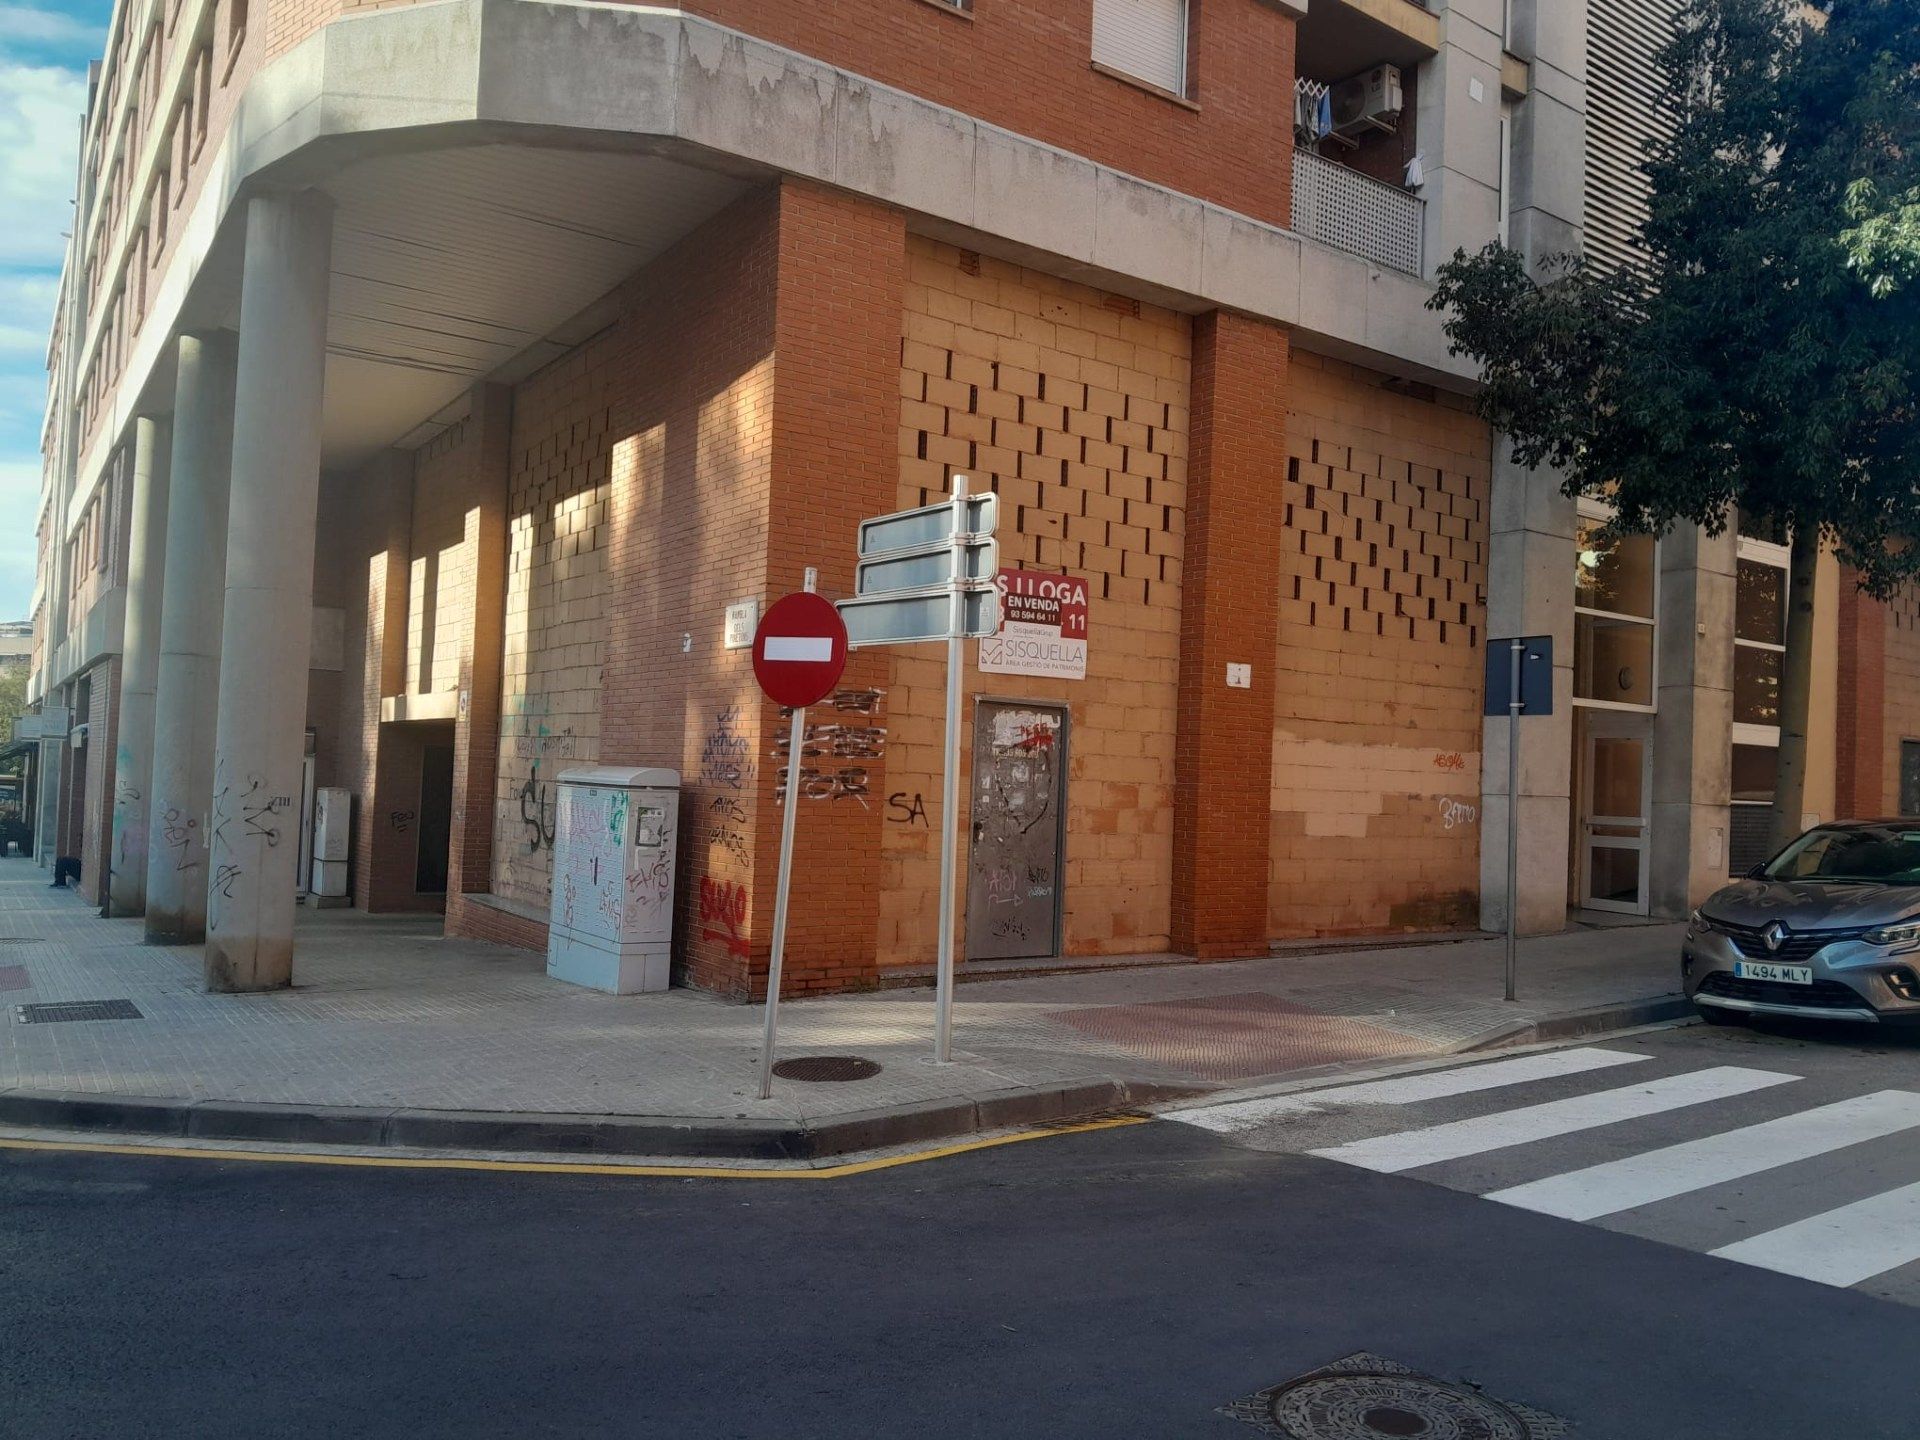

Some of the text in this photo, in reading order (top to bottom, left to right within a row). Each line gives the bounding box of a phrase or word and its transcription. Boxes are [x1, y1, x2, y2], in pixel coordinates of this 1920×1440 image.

[1008, 595, 1060, 612] EN VENDA
[1011, 610, 1020, 618] 93
[1048, 613, 1056, 622] 11
[1069, 613, 1085, 631] 11
[1005, 639, 1083, 662] SISQUELLA
[887, 792, 929, 828] SA
[1745, 965, 1808, 981] 1494 MLY
